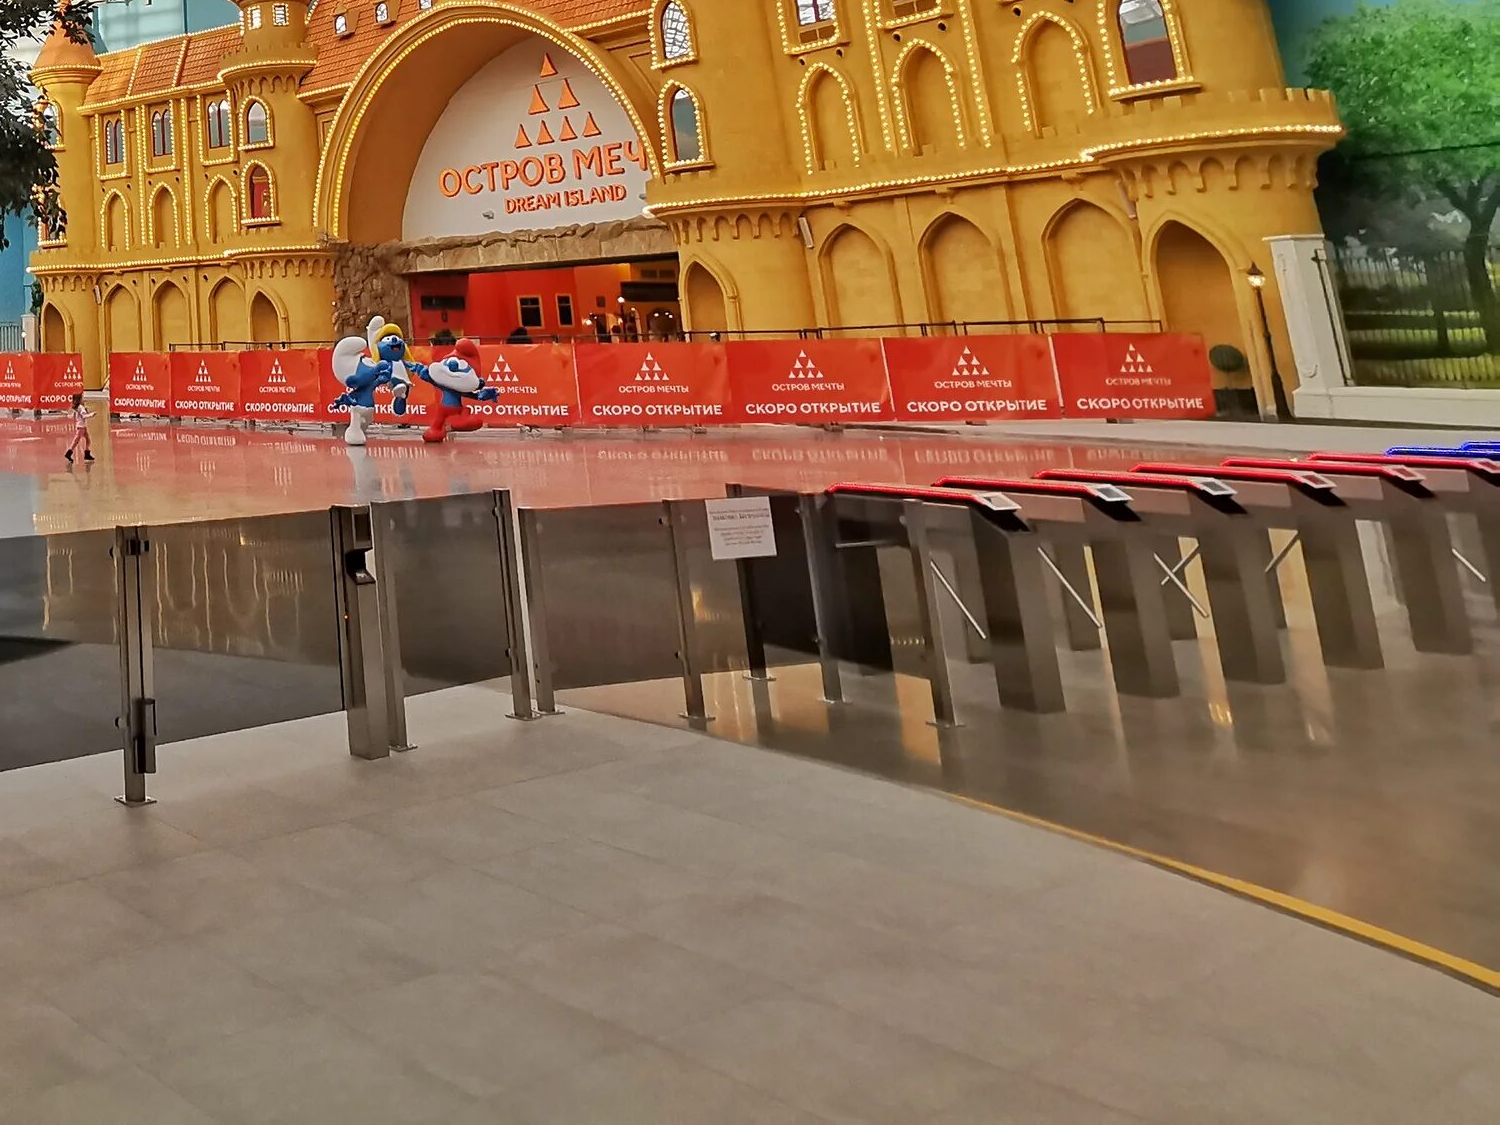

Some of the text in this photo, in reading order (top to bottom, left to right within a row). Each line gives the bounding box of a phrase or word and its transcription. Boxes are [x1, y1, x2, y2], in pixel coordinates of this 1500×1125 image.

[439, 141, 649, 197] ОСТРОВ МЕЧ
[505, 184, 627, 214] DREAM ISLAND
[771, 382, 845, 391] ОСТРОВ МЕЧТЫ
[934, 379, 1012, 389] ОСТРОВ МЕЧТЫ
[1105, 377, 1140, 386] ОСТРОВ
[507, 386, 537, 394] МЕЧТЫ
[618, 385, 689, 393] ОСТРОВ МЕЧТЫ
[40, 395, 66, 403] СКОРО
[114, 398, 166, 408] СКОРО ОТКРЫТИЕ
[1076, 397, 1204, 409] СКОРО ОТКРЫТИЕ
[175, 400, 234, 411] СКОРО ОТКРЫТИЕ
[245, 402, 314, 413] СКОРО ОТКРЫТИЕ
[374, 404, 427, 415] ТКРТИЕ
[496, 405, 569, 416] ОТКРЫТИЕ
[592, 404, 722, 416] СКОРО ОТКРЫТИЕ
[745, 402, 881, 415] СКОРО ОТКРЫТИЕ
[907, 399, 1047, 413] СКОРО ОТКРЫТИЕ
